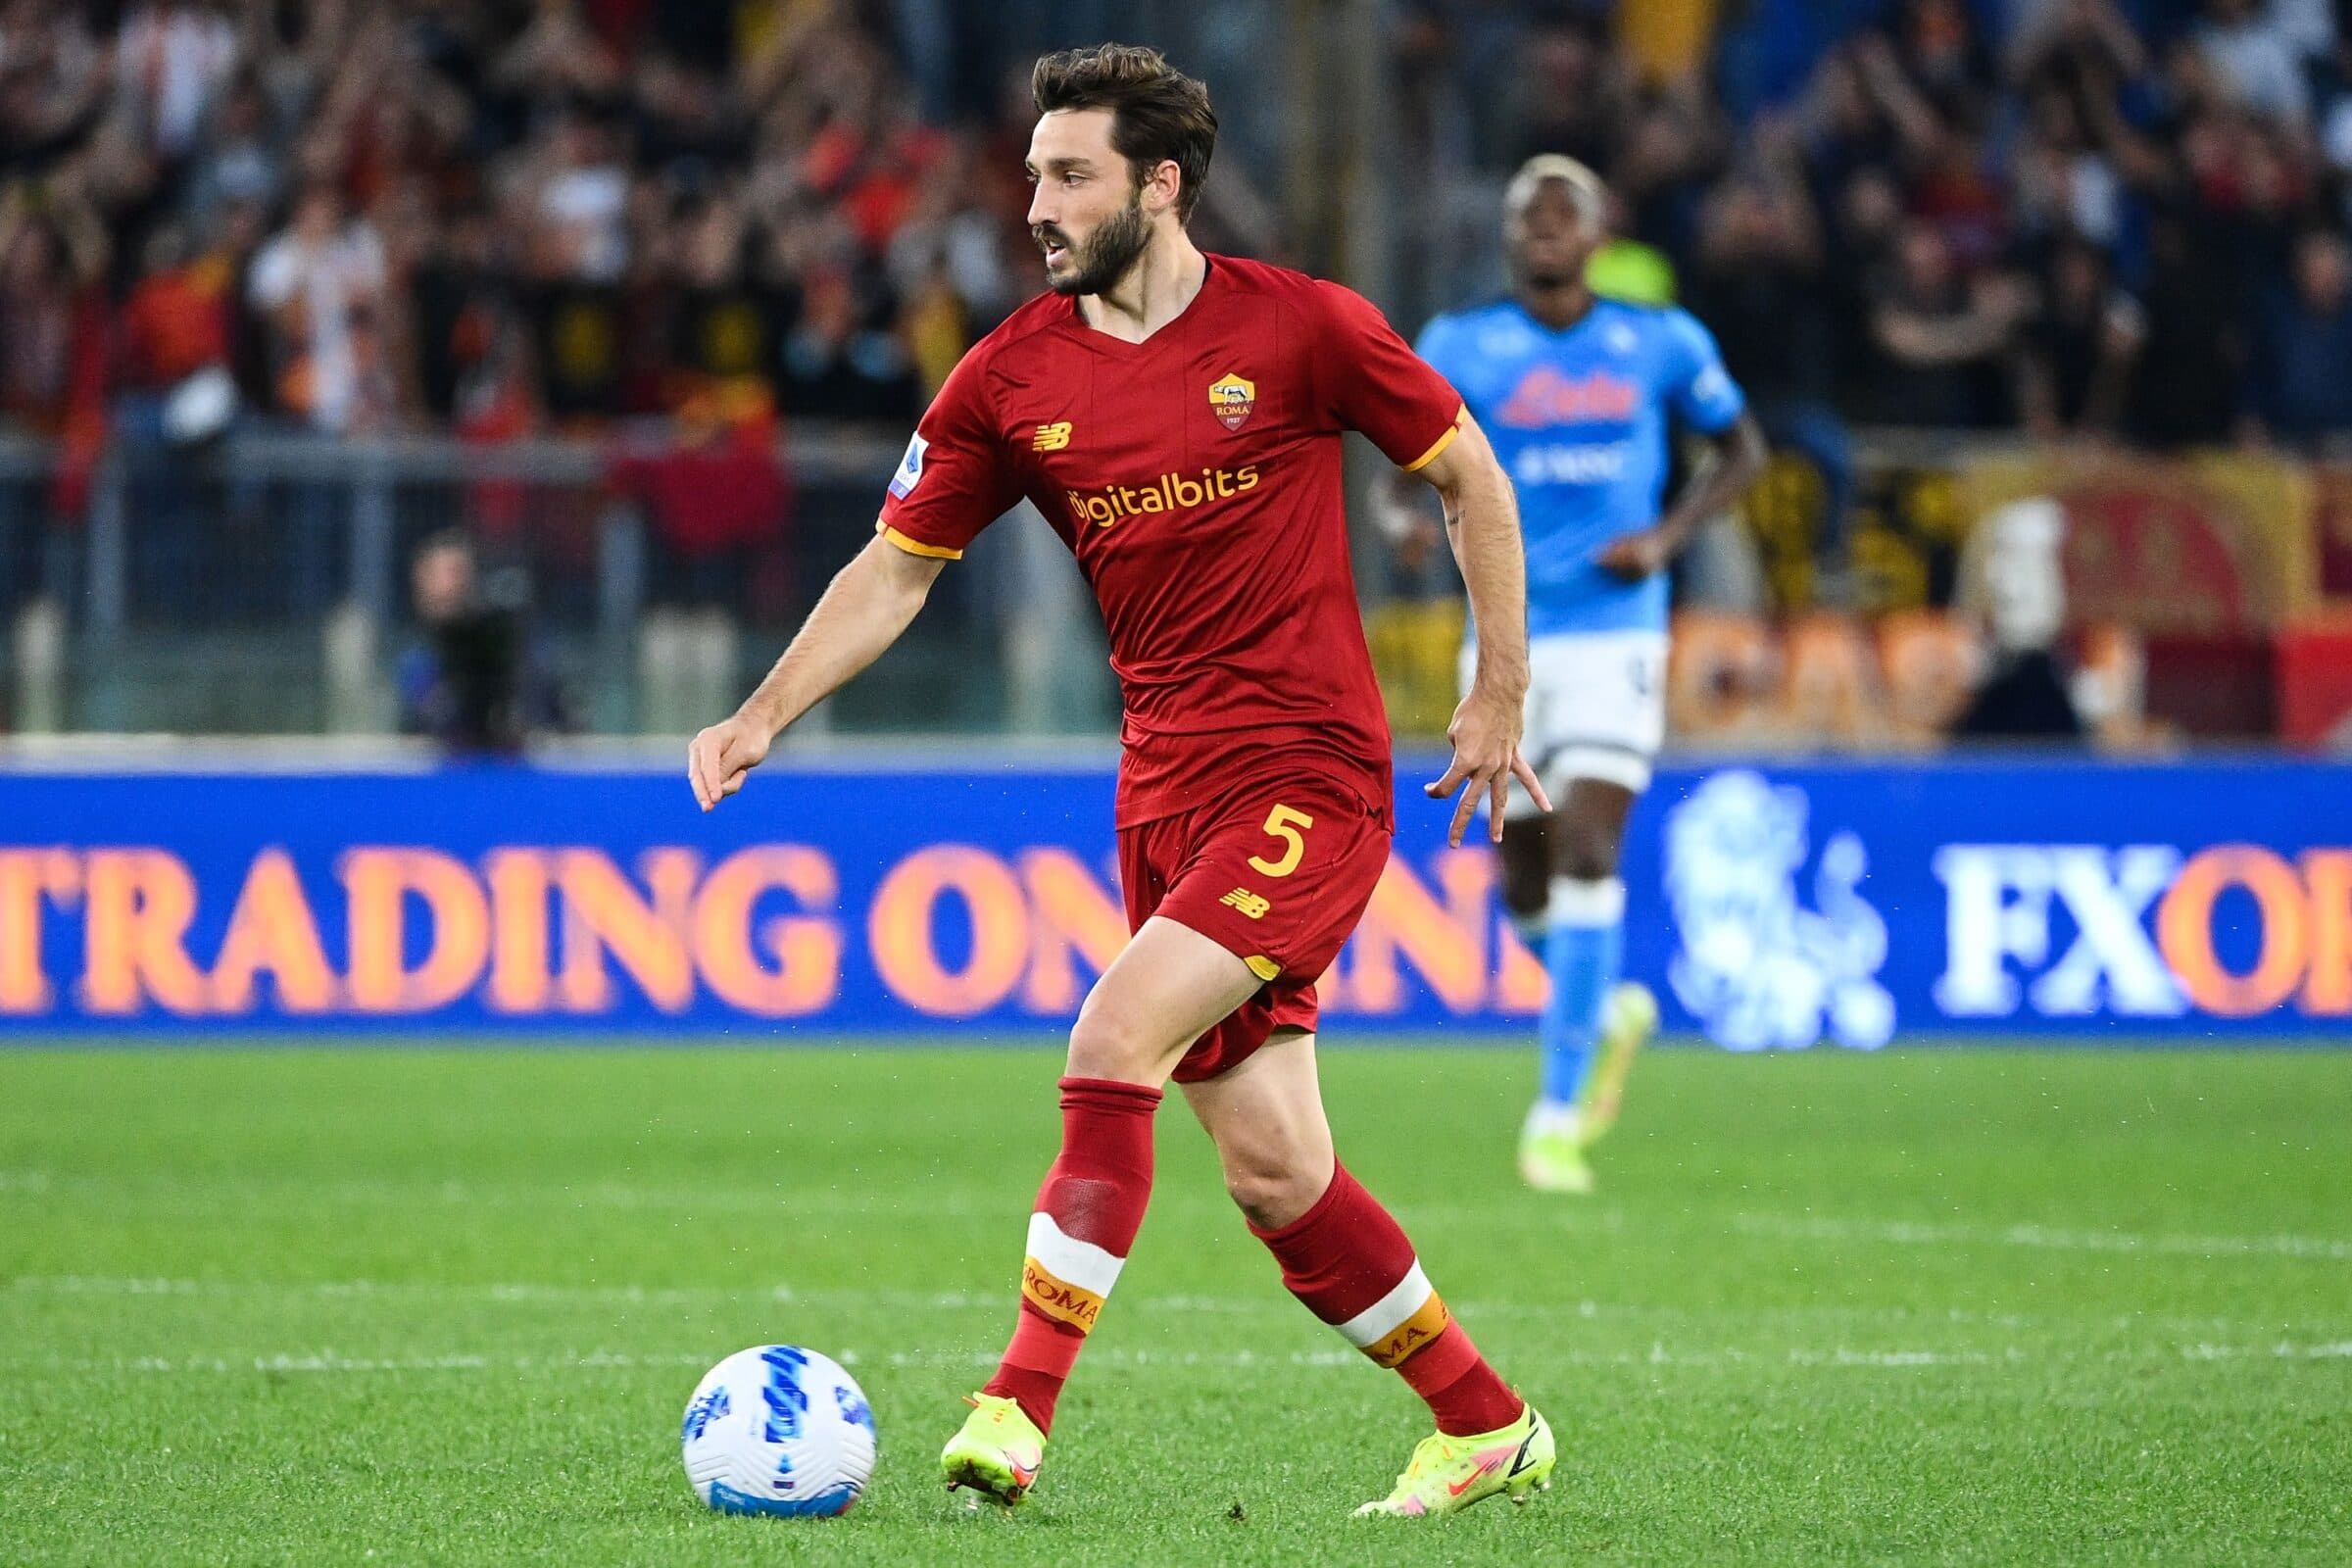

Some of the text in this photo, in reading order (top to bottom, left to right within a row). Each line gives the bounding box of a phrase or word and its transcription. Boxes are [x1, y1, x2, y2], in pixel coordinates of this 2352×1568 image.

[1216, 406, 1250, 416] ROMA
[1067, 465, 1259, 528] digitalbits
[1247, 803, 1314, 878] 5
[0, 844, 843, 1017] TRADING
[1025, 1266, 1099, 1325] ROMA
